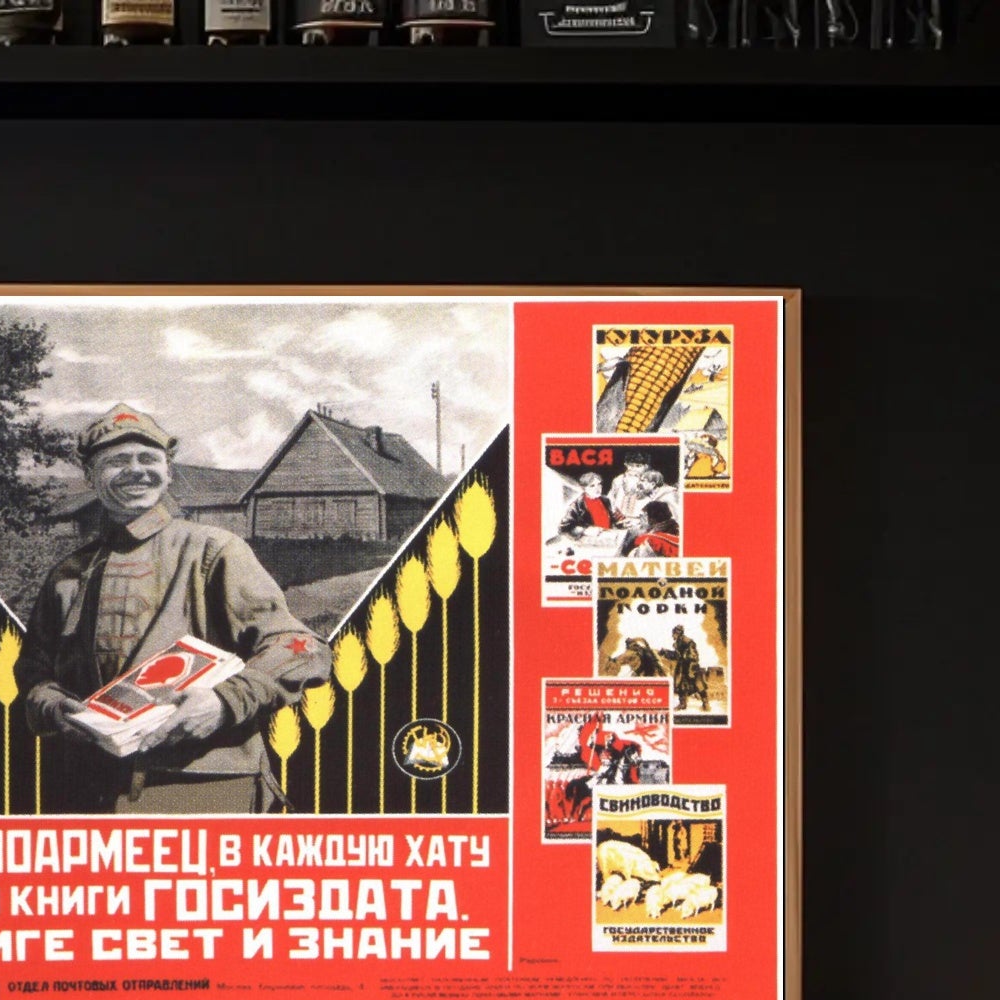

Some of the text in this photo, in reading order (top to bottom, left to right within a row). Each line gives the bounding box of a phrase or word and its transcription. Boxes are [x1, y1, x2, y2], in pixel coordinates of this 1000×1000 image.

[549, 448, 614, 466] ВАСЯ
[597, 559, 728, 577] МАТВЕЙ
[599, 586, 726, 599] ГОЛОДНОЙ
[617, 603, 708, 615] ГОРКИ
[599, 793, 722, 813] СВИНОВОДСТВО
[219, 834, 242, 867] В
[253, 834, 395, 867] КАЖДУЮ
[405, 834, 490, 868] ХАТУ
[10, 885, 131, 916] КНИГИ
[144, 878, 470, 921] ГОСИЗДАТА.
[603, 926, 716, 935] ГОСУДАРСТВЕННОЕ
[91, 927, 224, 961] СВЕТ
[242, 927, 274, 960] И
[288, 926, 491, 960] ЗНАНИЕ
[7, 980, 50, 993] ОТДЕЛ
[52, 979, 118, 992] ПОЧТОВЫХ
[122, 977, 211, 991] ОТПРАВЛЕНИЙ
